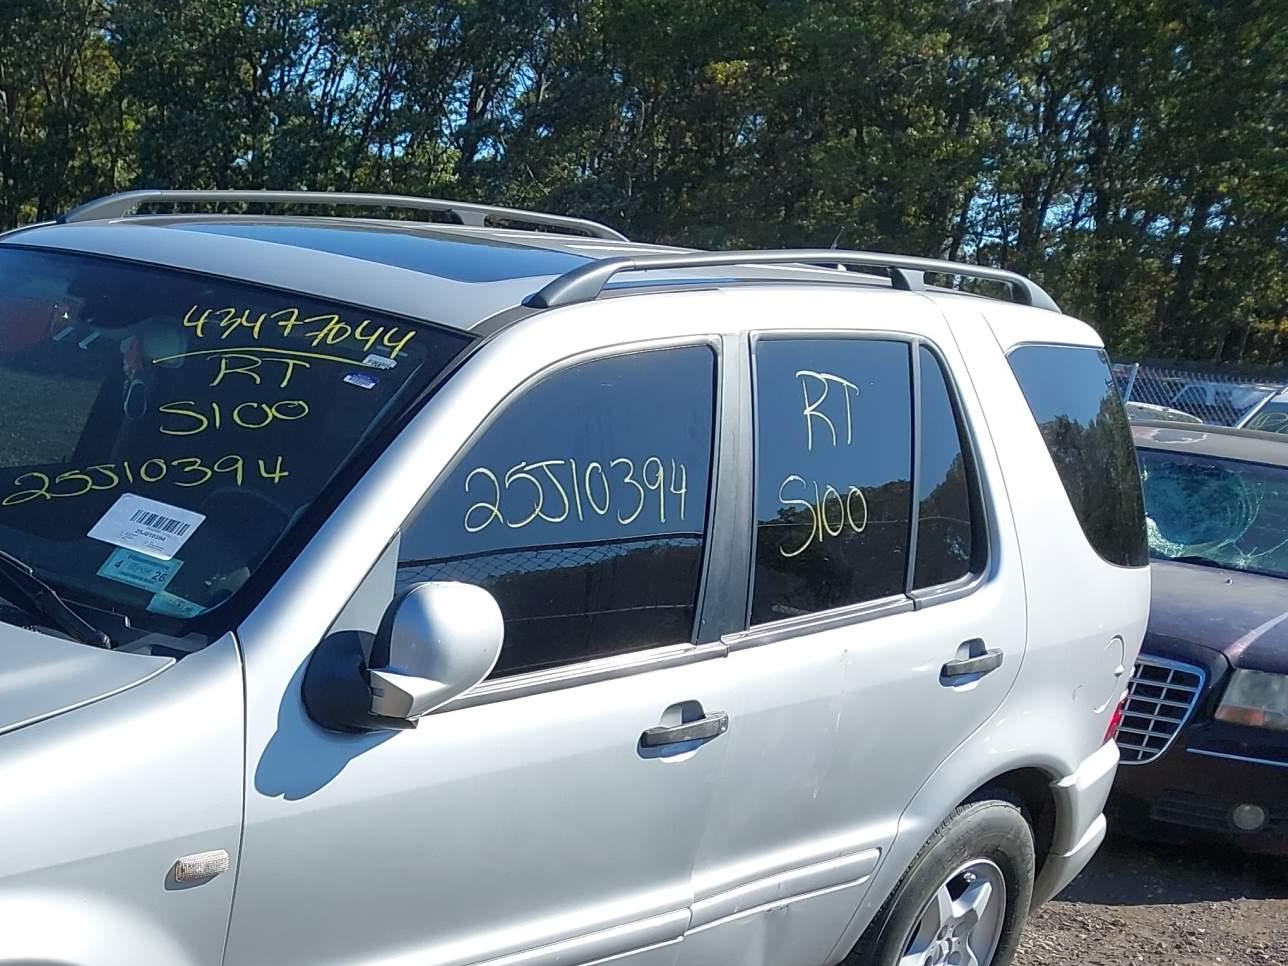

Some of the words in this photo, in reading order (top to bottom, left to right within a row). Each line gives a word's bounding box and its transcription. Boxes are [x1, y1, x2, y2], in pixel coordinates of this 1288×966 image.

[183, 305, 416, 358] 43477044
[208, 354, 311, 388] RT
[796, 370, 860, 450] RT
[2, 455, 289, 505] 25J10394
[465, 456, 688, 533] 25J10394
[778, 474, 868, 558] S100
